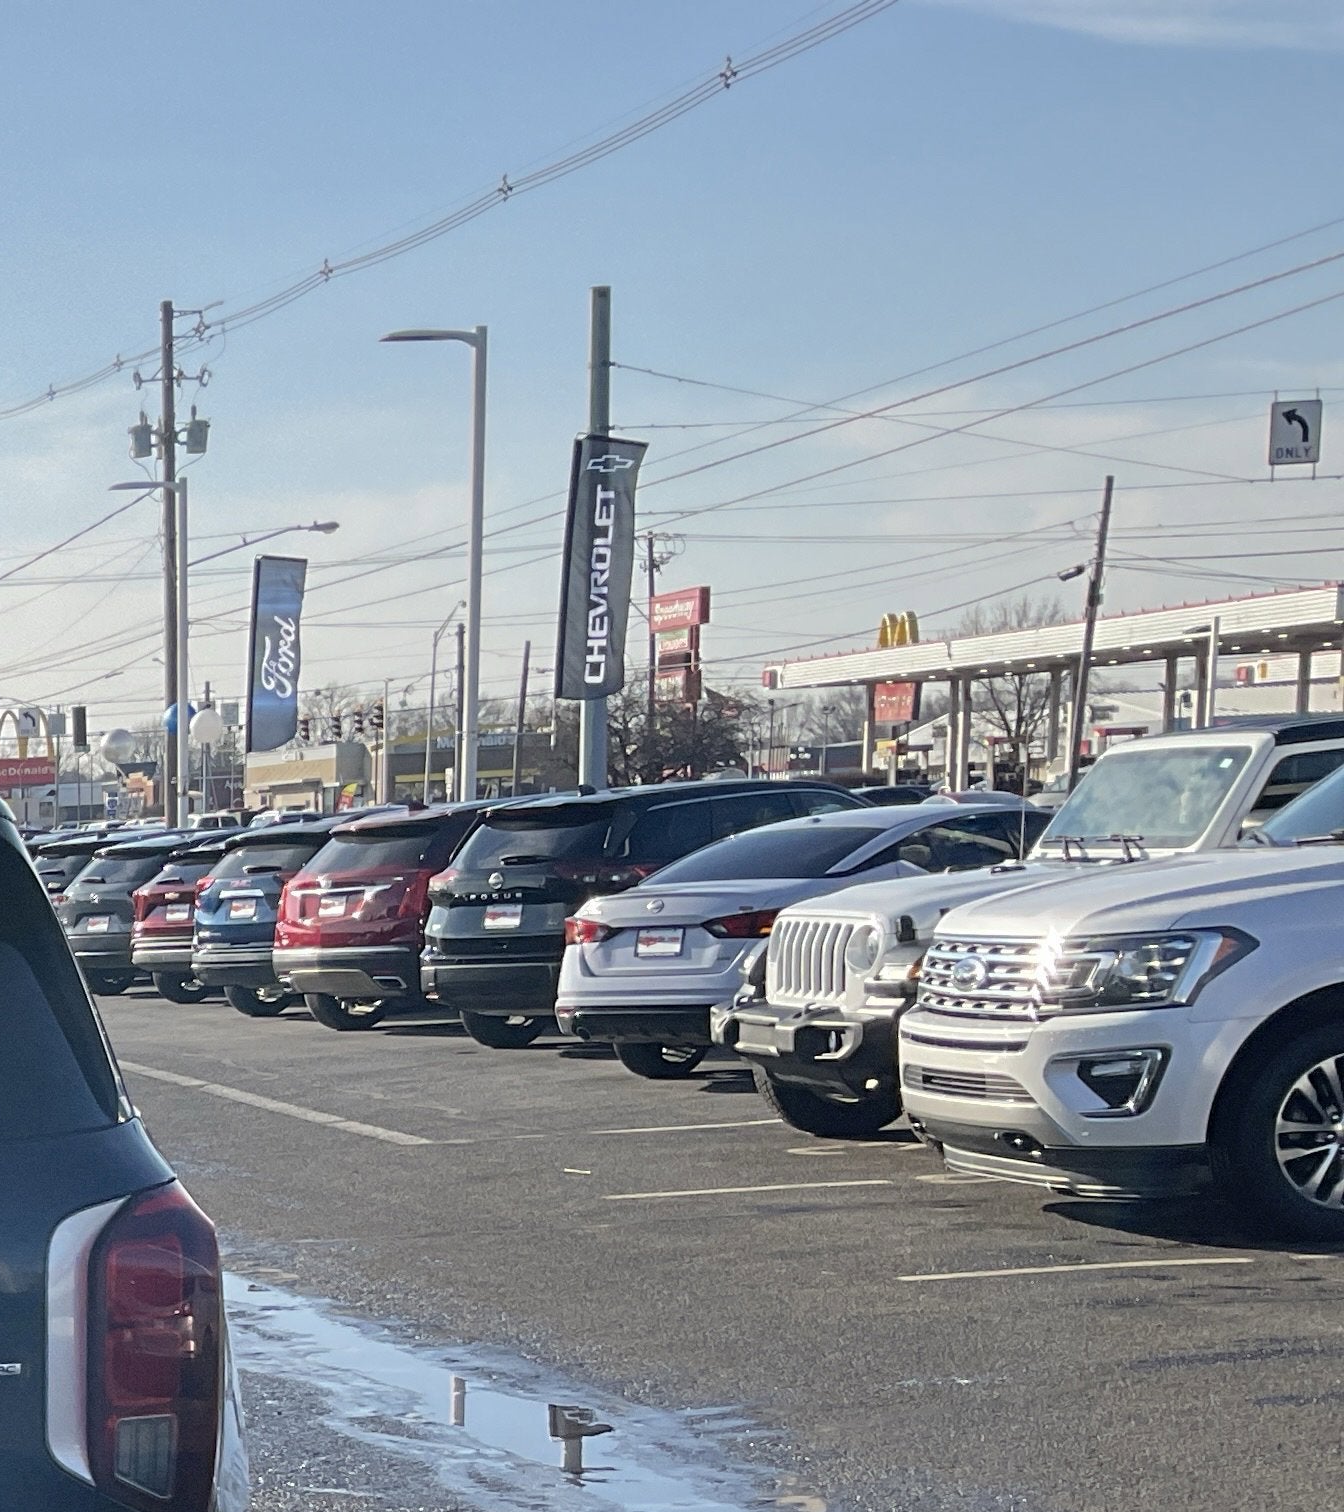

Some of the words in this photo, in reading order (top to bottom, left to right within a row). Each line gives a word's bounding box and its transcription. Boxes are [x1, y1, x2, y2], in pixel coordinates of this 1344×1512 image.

[1275, 447, 1312, 459] ONLY
[584, 484, 615, 684] CHEVROLET
[262, 615, 296, 699] Ford
